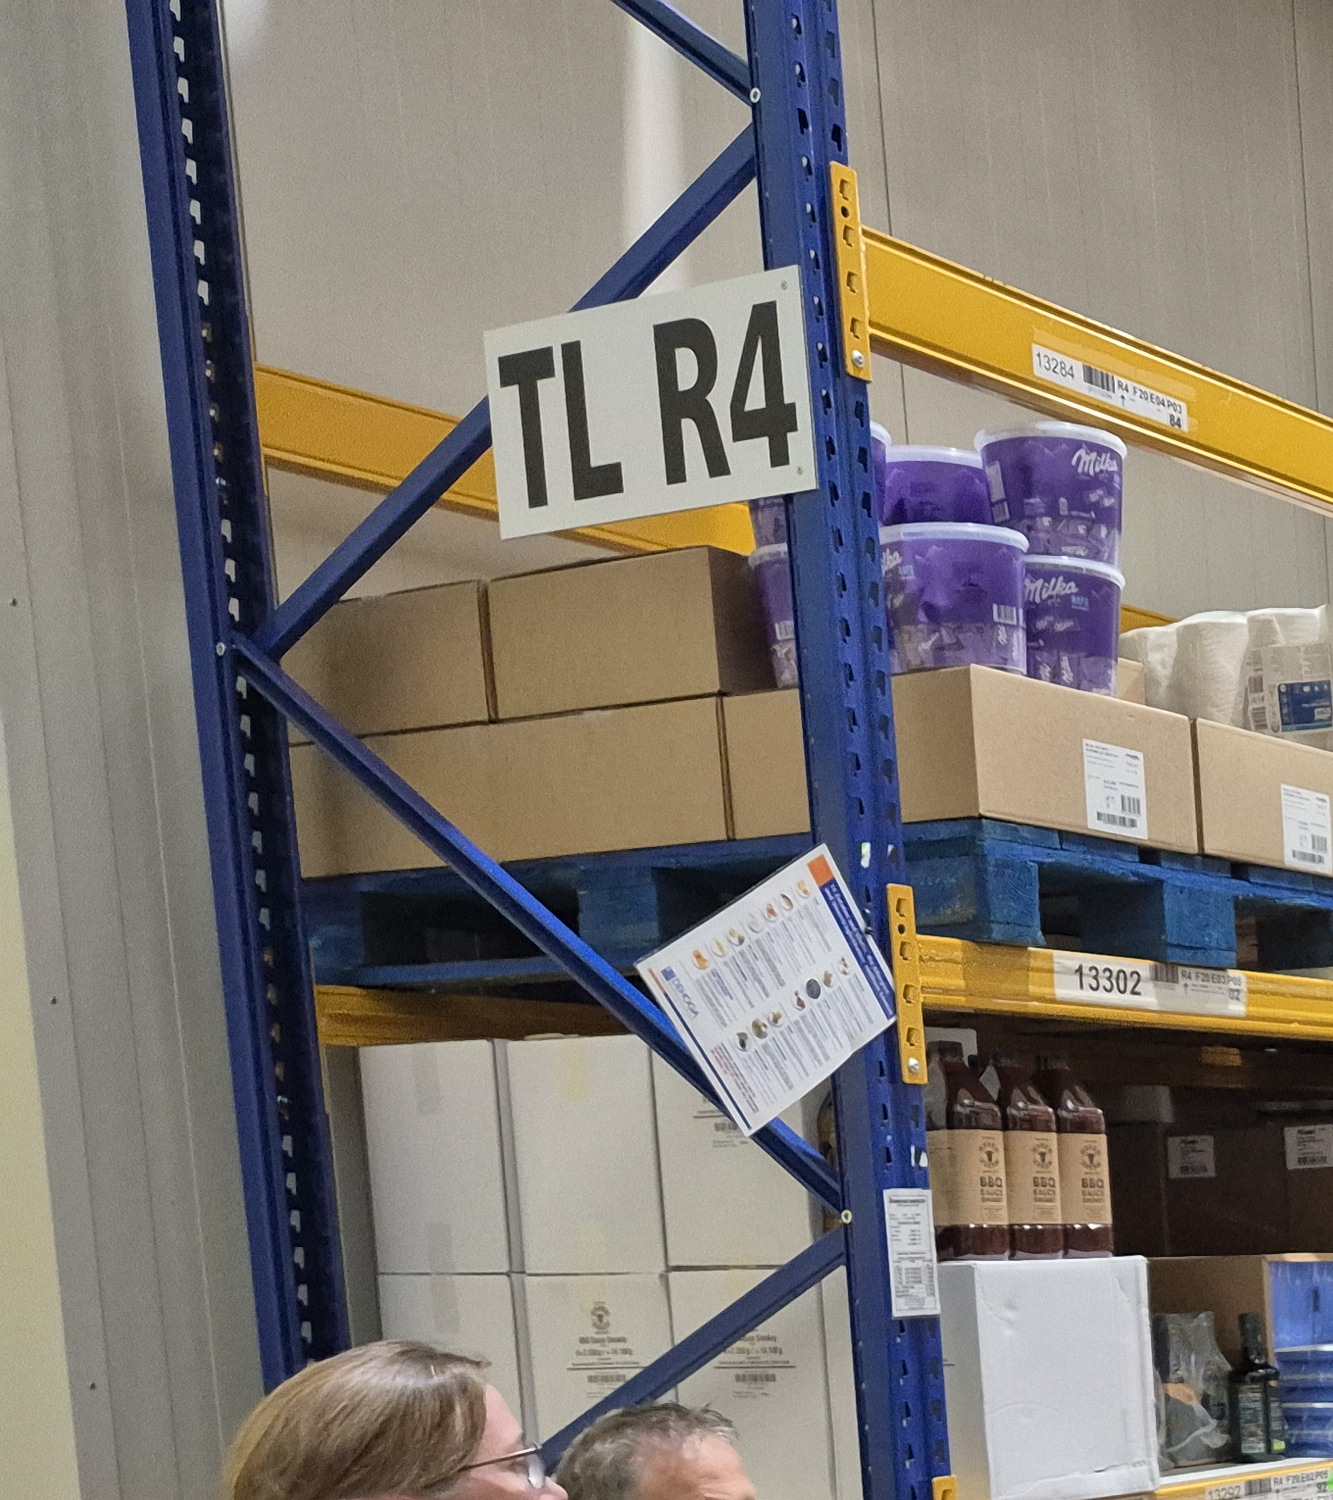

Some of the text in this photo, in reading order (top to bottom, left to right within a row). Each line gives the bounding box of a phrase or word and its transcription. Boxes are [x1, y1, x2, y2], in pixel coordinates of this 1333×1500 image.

[1036, 351, 1076, 380] 13284
[1117, 379, 1129, 394] R4
[1133, 386, 1149, 401] F20
[1150, 393, 1166, 408] E04
[498, 300, 799, 509] TL R4
[1169, 413, 1183, 430] 84
[1071, 447, 1120, 476] Milka
[1025, 575, 1079, 603] Milka
[1074, 962, 1142, 996] 13302
[1181, 969, 1192, 981] R4
[980, 1175, 1003, 1188] BBQ
[1032, 1176, 1056, 1188] BBQ
[1081, 1177, 1105, 1189] BBQ
[1273, 1477, 1283, 1487] R4
